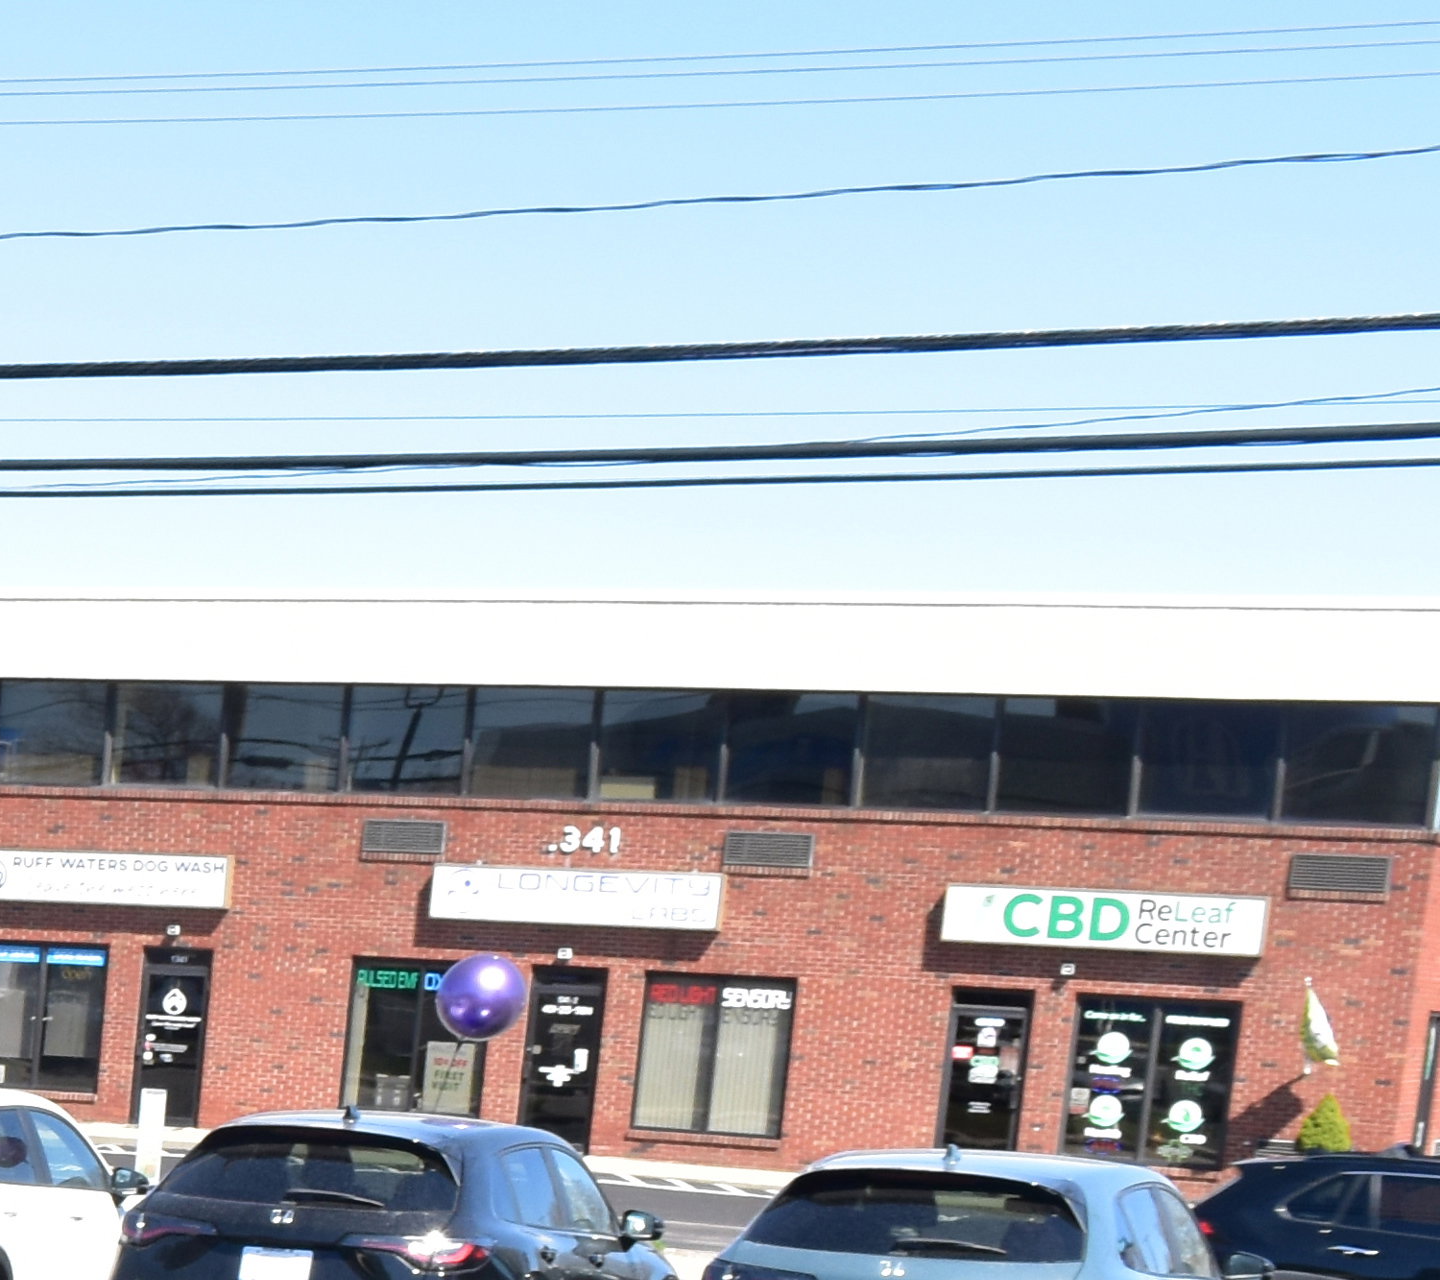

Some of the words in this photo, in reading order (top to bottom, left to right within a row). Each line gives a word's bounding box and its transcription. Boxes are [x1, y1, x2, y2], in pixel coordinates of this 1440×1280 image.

[12, 856, 55, 869] RUFF
[60, 857, 128, 872] WATERS
[133, 860, 169, 873] DOG
[174, 862, 225, 874] WASH
[1002, 893, 1131, 942] CBD
[1138, 898, 1237, 924] ReLeaf
[1134, 922, 1233, 949] Center
